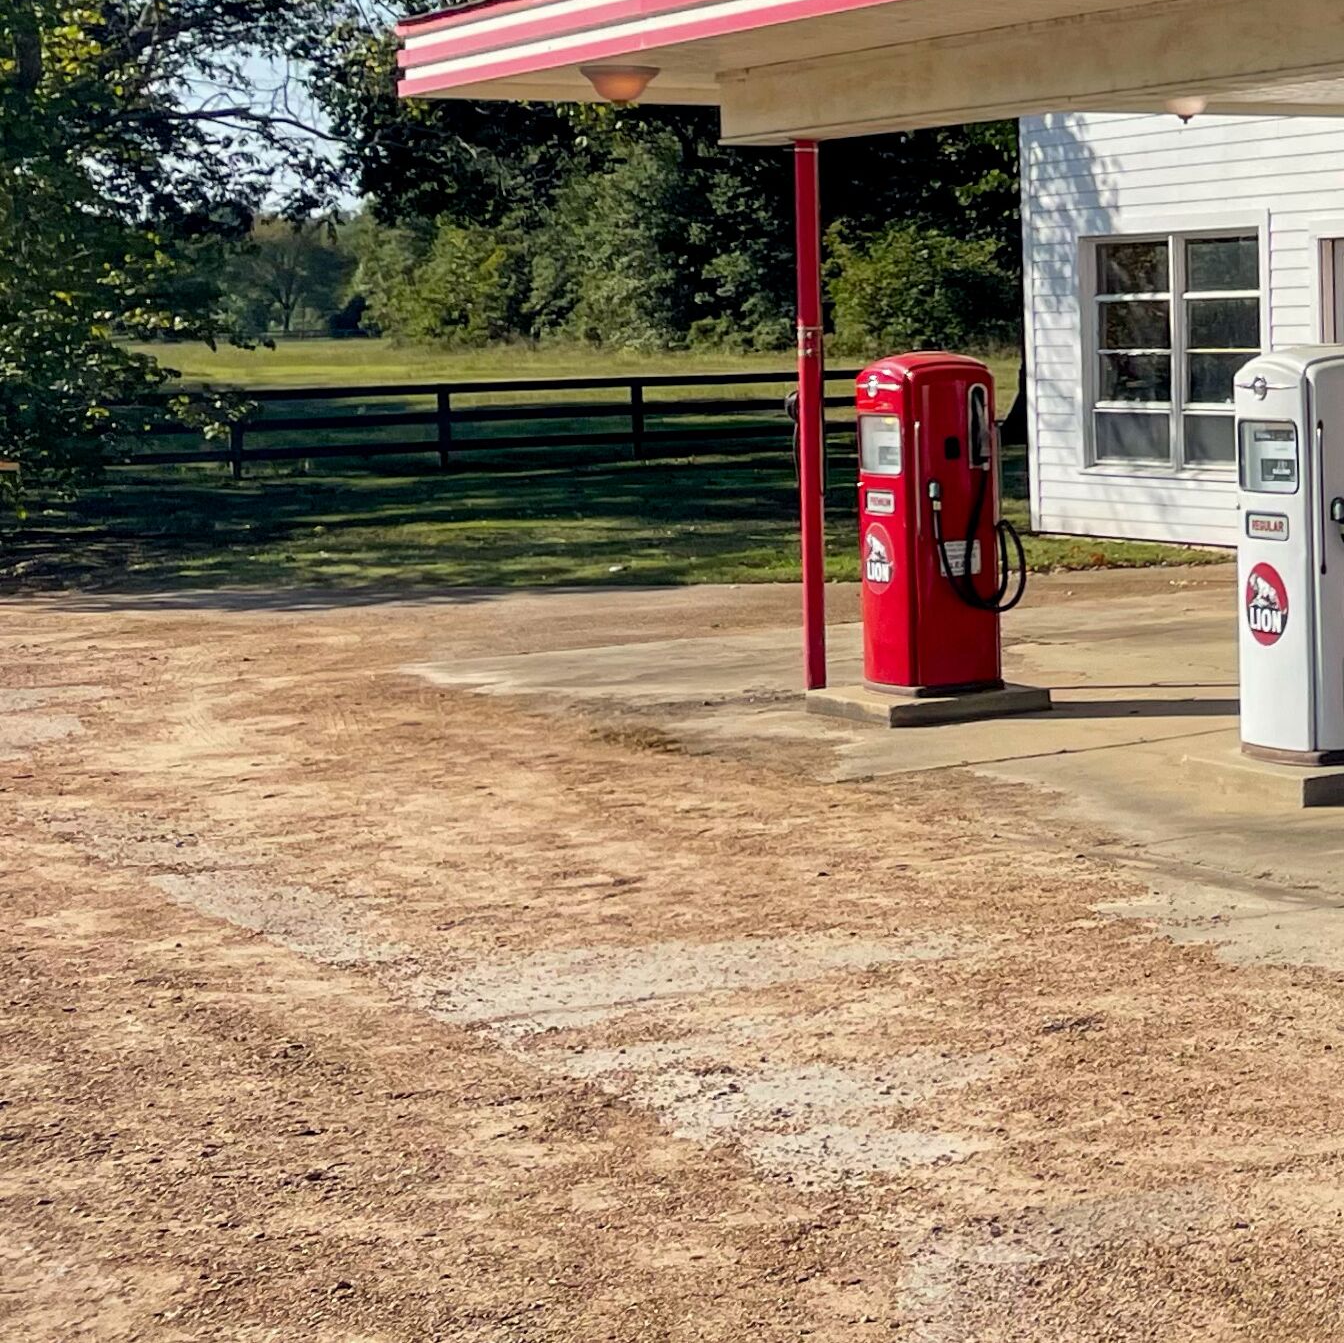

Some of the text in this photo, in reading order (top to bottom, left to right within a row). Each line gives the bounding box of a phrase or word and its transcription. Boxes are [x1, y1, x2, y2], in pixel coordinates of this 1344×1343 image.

[1252, 519, 1285, 533] REGULAR
[866, 560, 890, 583] LION
[1249, 606, 1282, 634] LION
